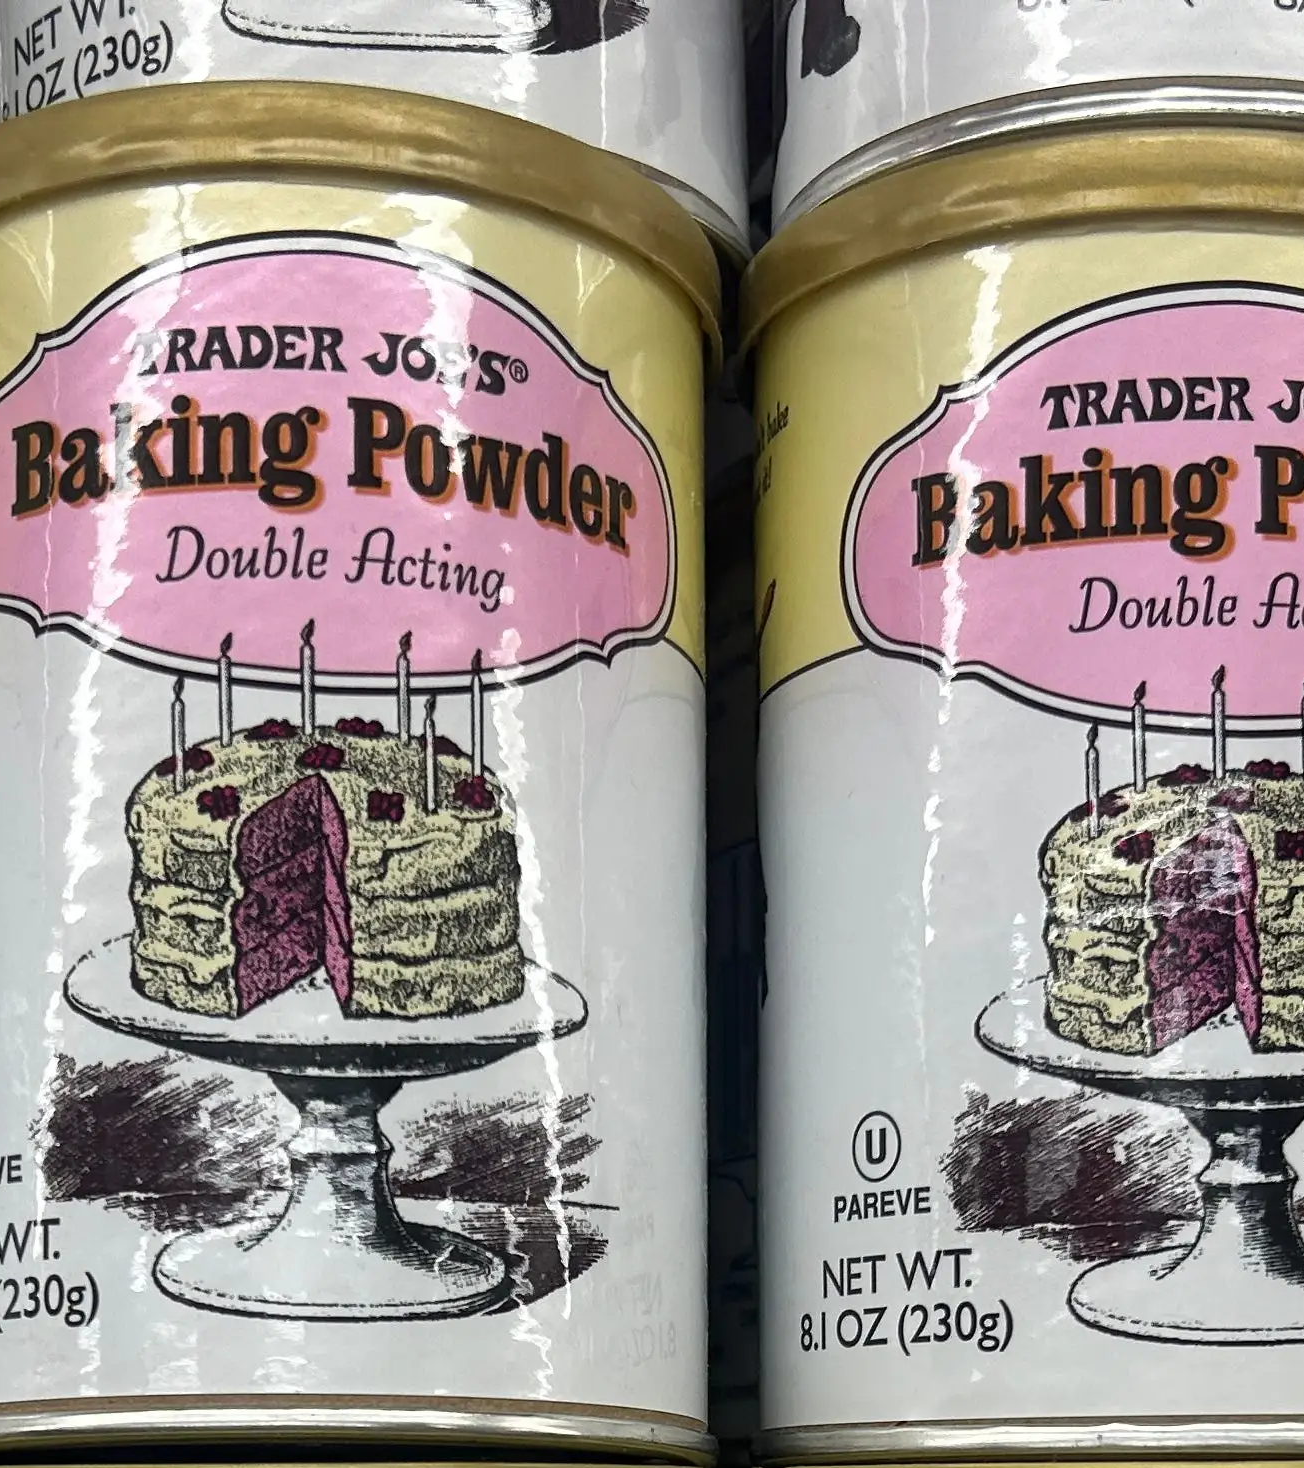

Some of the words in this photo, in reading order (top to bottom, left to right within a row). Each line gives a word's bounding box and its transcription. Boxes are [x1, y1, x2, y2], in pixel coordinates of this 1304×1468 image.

[14, 7, 62, 76] NET
[74, 20, 174, 99] (230g)
[136, 325, 347, 377] TRADER
[1041, 376, 1254, 431] TRADER
[12, 395, 328, 520] Baking
[347, 395, 636, 553] Powder
[911, 447, 1239, 561] Baking
[157, 526, 328, 585] Double
[346, 527, 505, 611] Acting
[1069, 575, 1238, 634] Double
[833, 1186, 931, 1223] PAREVE
[822, 1254, 886, 1299] NET
[895, 1248, 973, 1292] WT.
[800, 1311, 826, 1352] 8.1
[836, 1306, 888, 1349] OZ
[897, 1299, 1014, 1357] (230g)
